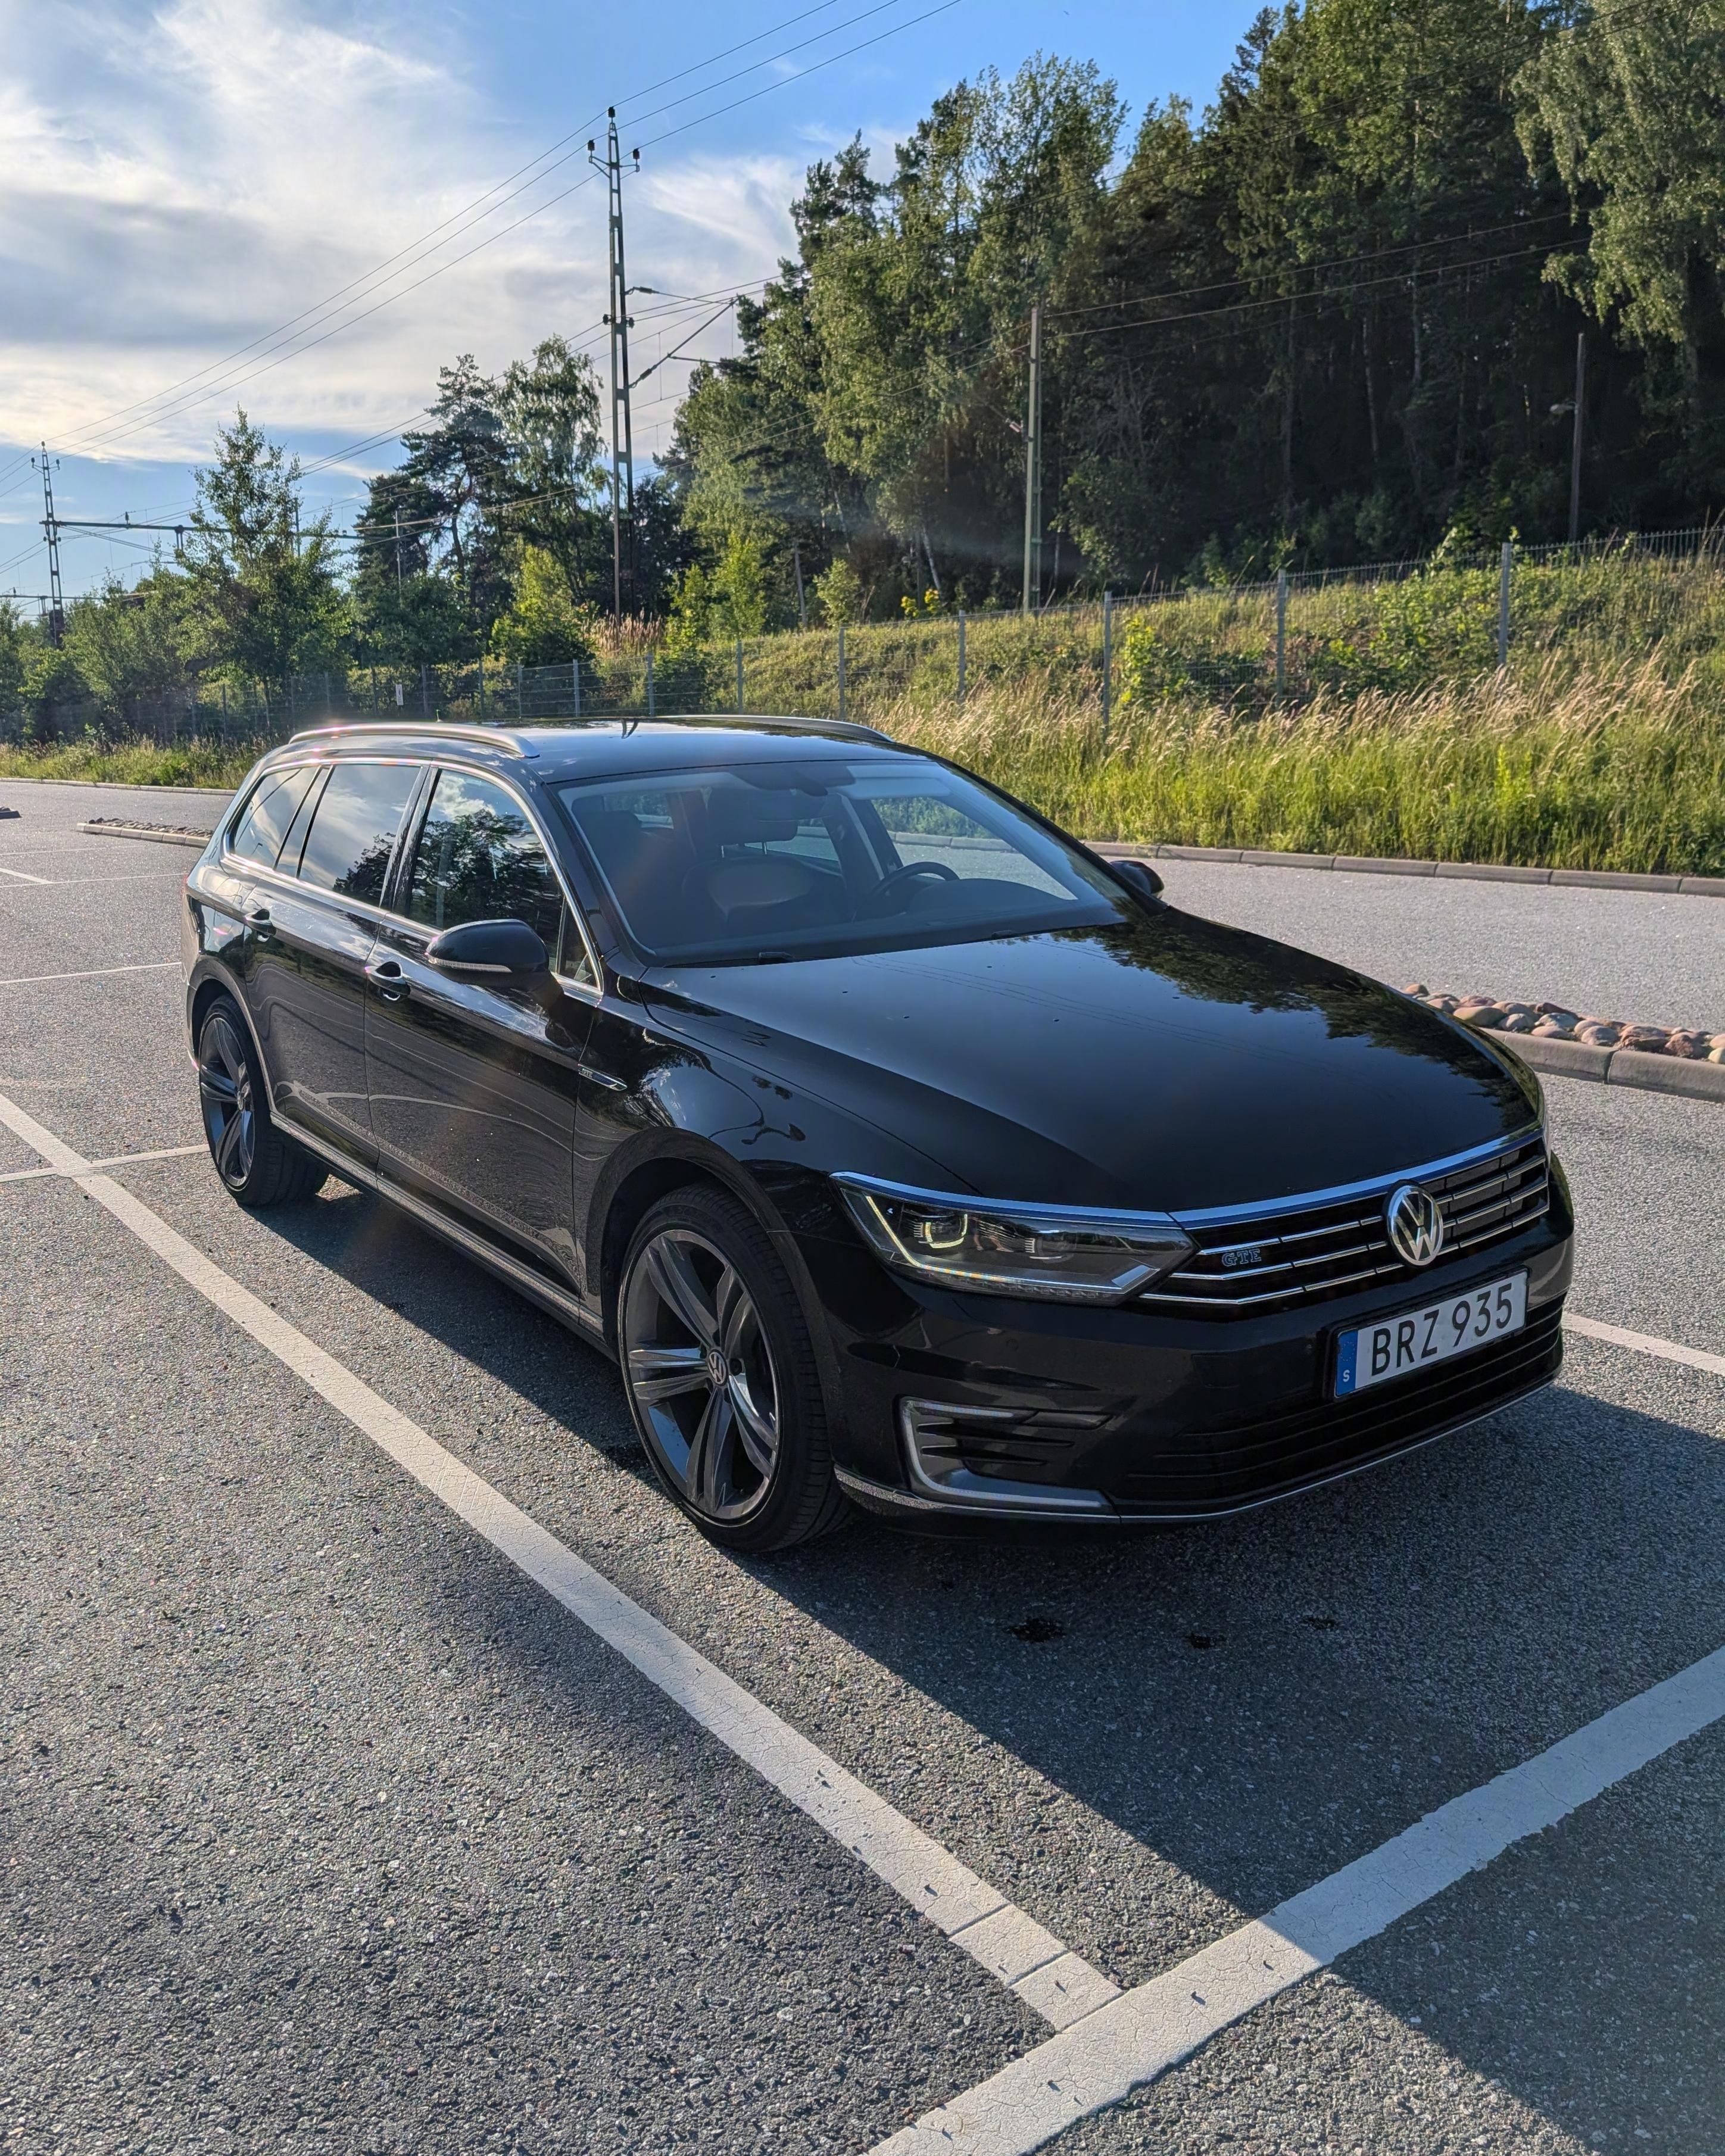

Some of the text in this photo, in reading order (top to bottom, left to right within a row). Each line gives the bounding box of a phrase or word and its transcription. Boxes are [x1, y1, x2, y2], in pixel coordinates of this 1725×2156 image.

[1222, 1248, 1262, 1266] GTE
[1371, 1283, 1512, 1377] BRZ 935
[1343, 1369, 1350, 1383] S
